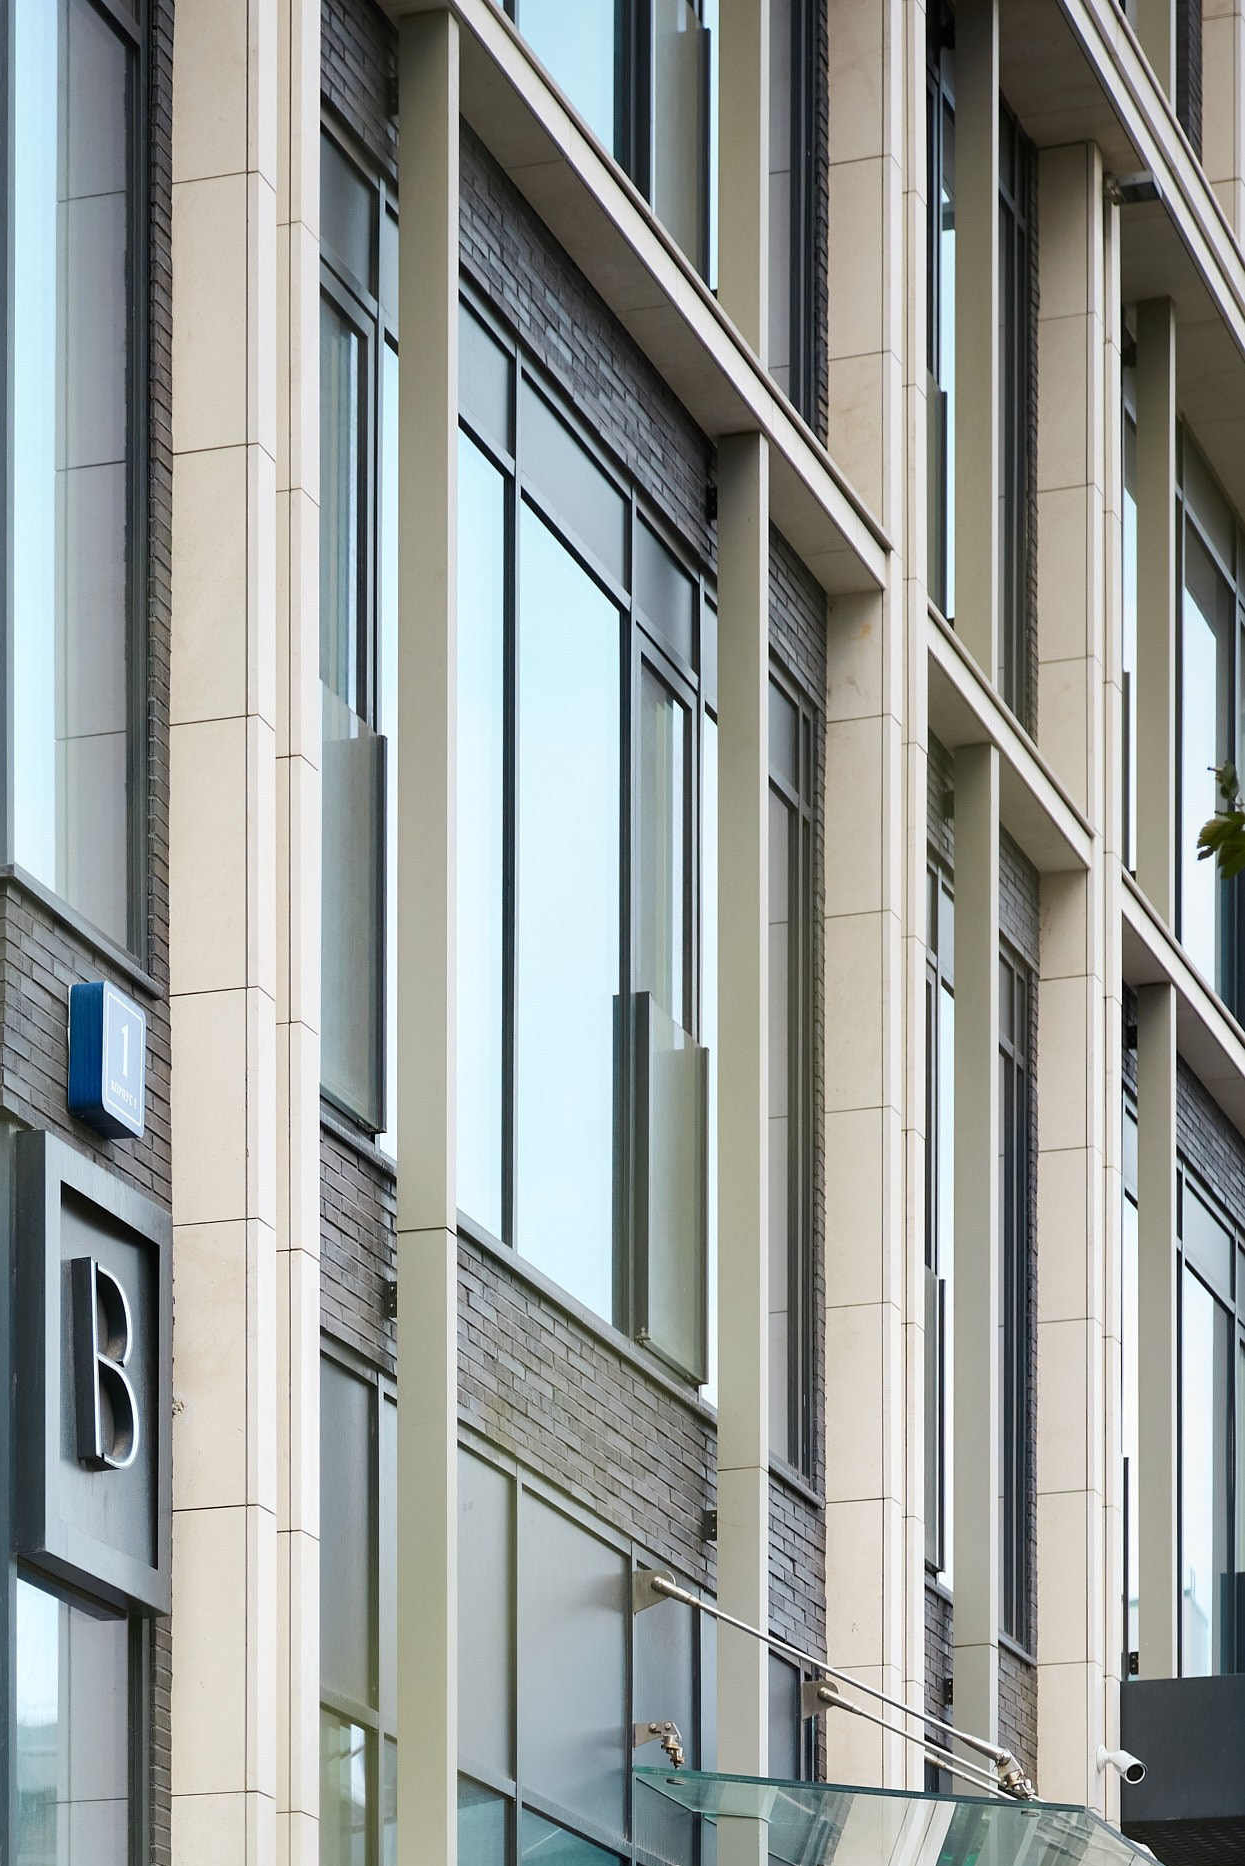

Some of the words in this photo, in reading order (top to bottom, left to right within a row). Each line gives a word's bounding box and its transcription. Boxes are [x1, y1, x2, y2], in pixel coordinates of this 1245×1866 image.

[120, 1024, 129, 1080] 1
[110, 1079, 133, 1107] КОРПУС
[72, 1257, 140, 1471] B
